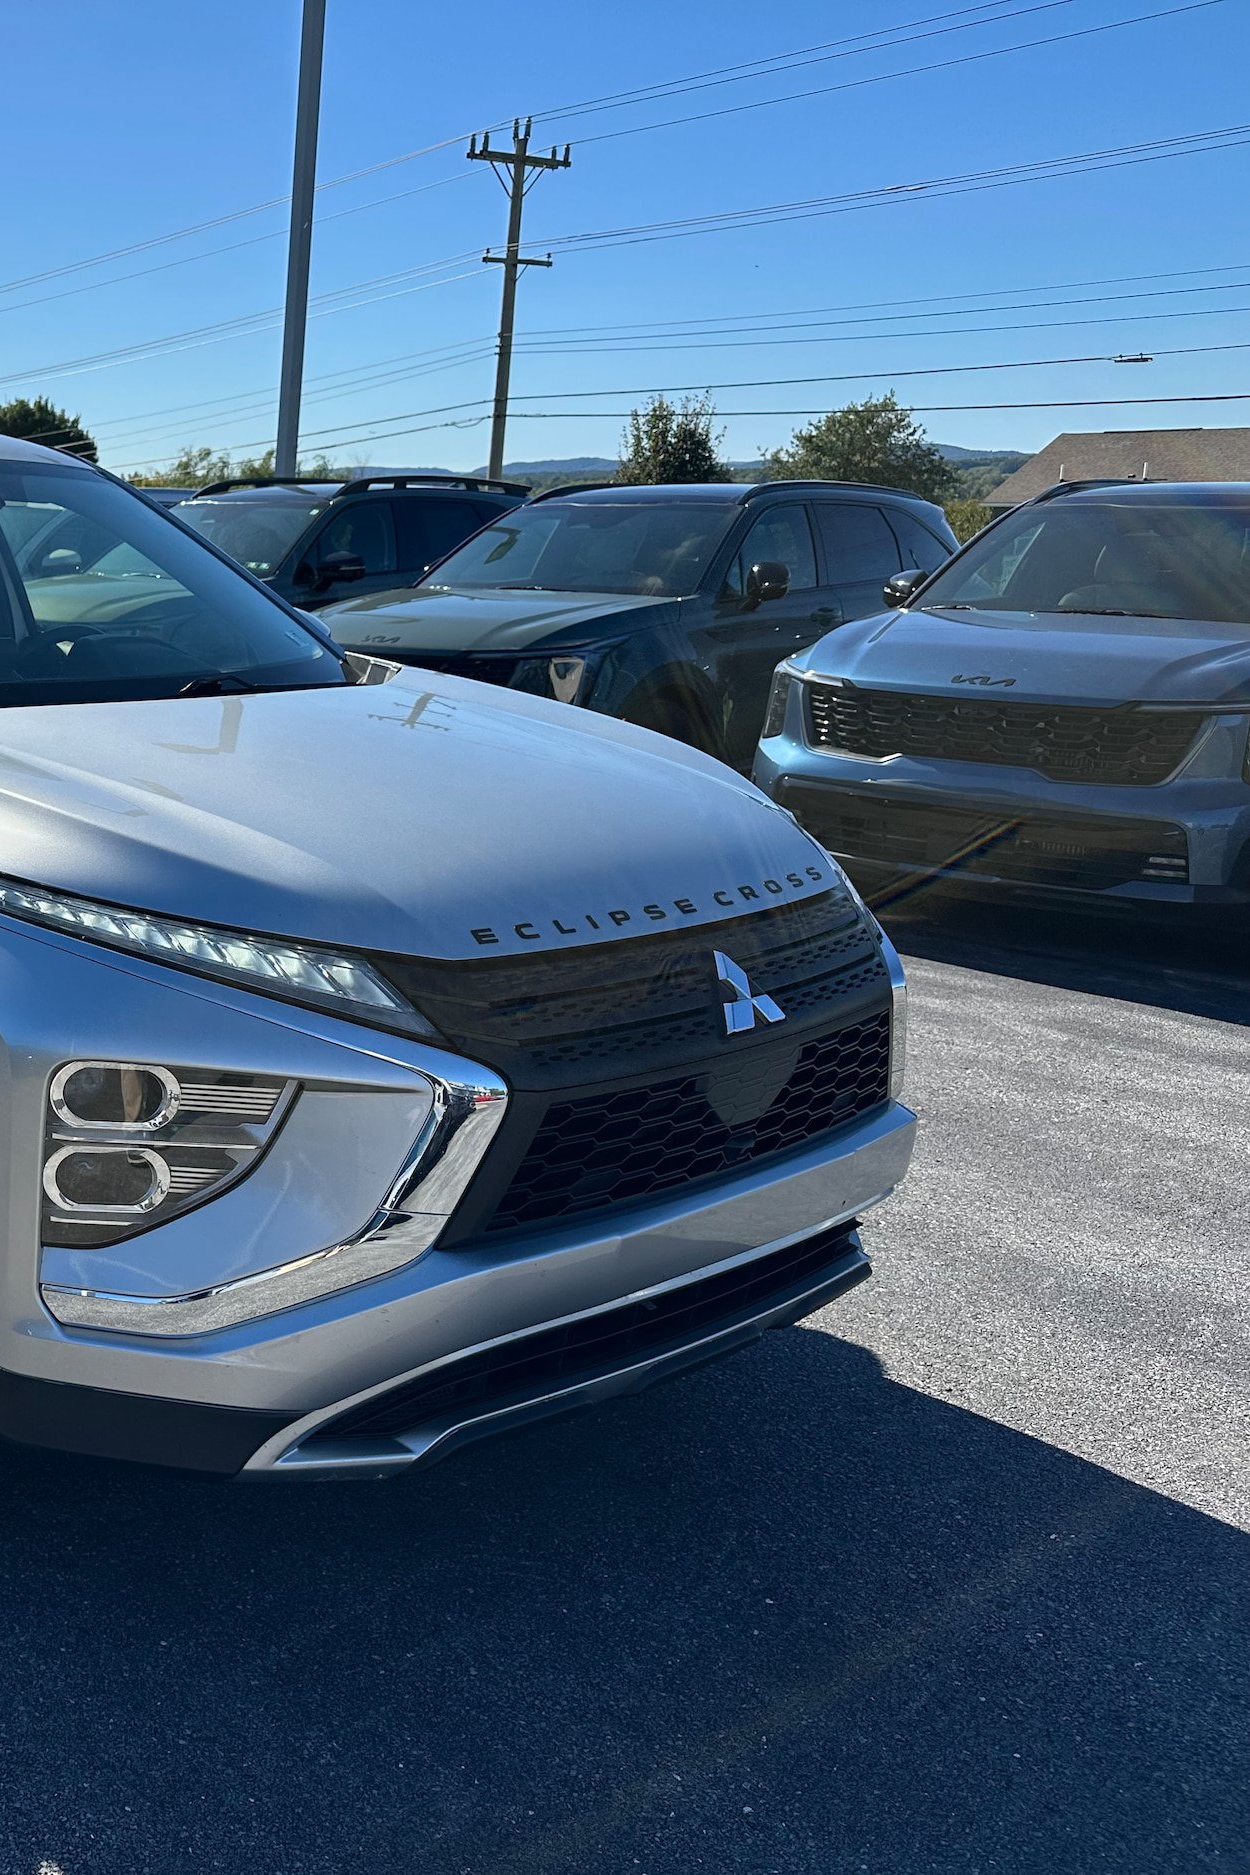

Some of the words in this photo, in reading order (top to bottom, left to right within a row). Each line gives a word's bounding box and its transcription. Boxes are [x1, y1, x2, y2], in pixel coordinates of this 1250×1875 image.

[950, 674, 1017, 688] KIA
[469, 897, 699, 945] ECLIPSE
[712, 866, 824, 907] CROSS
